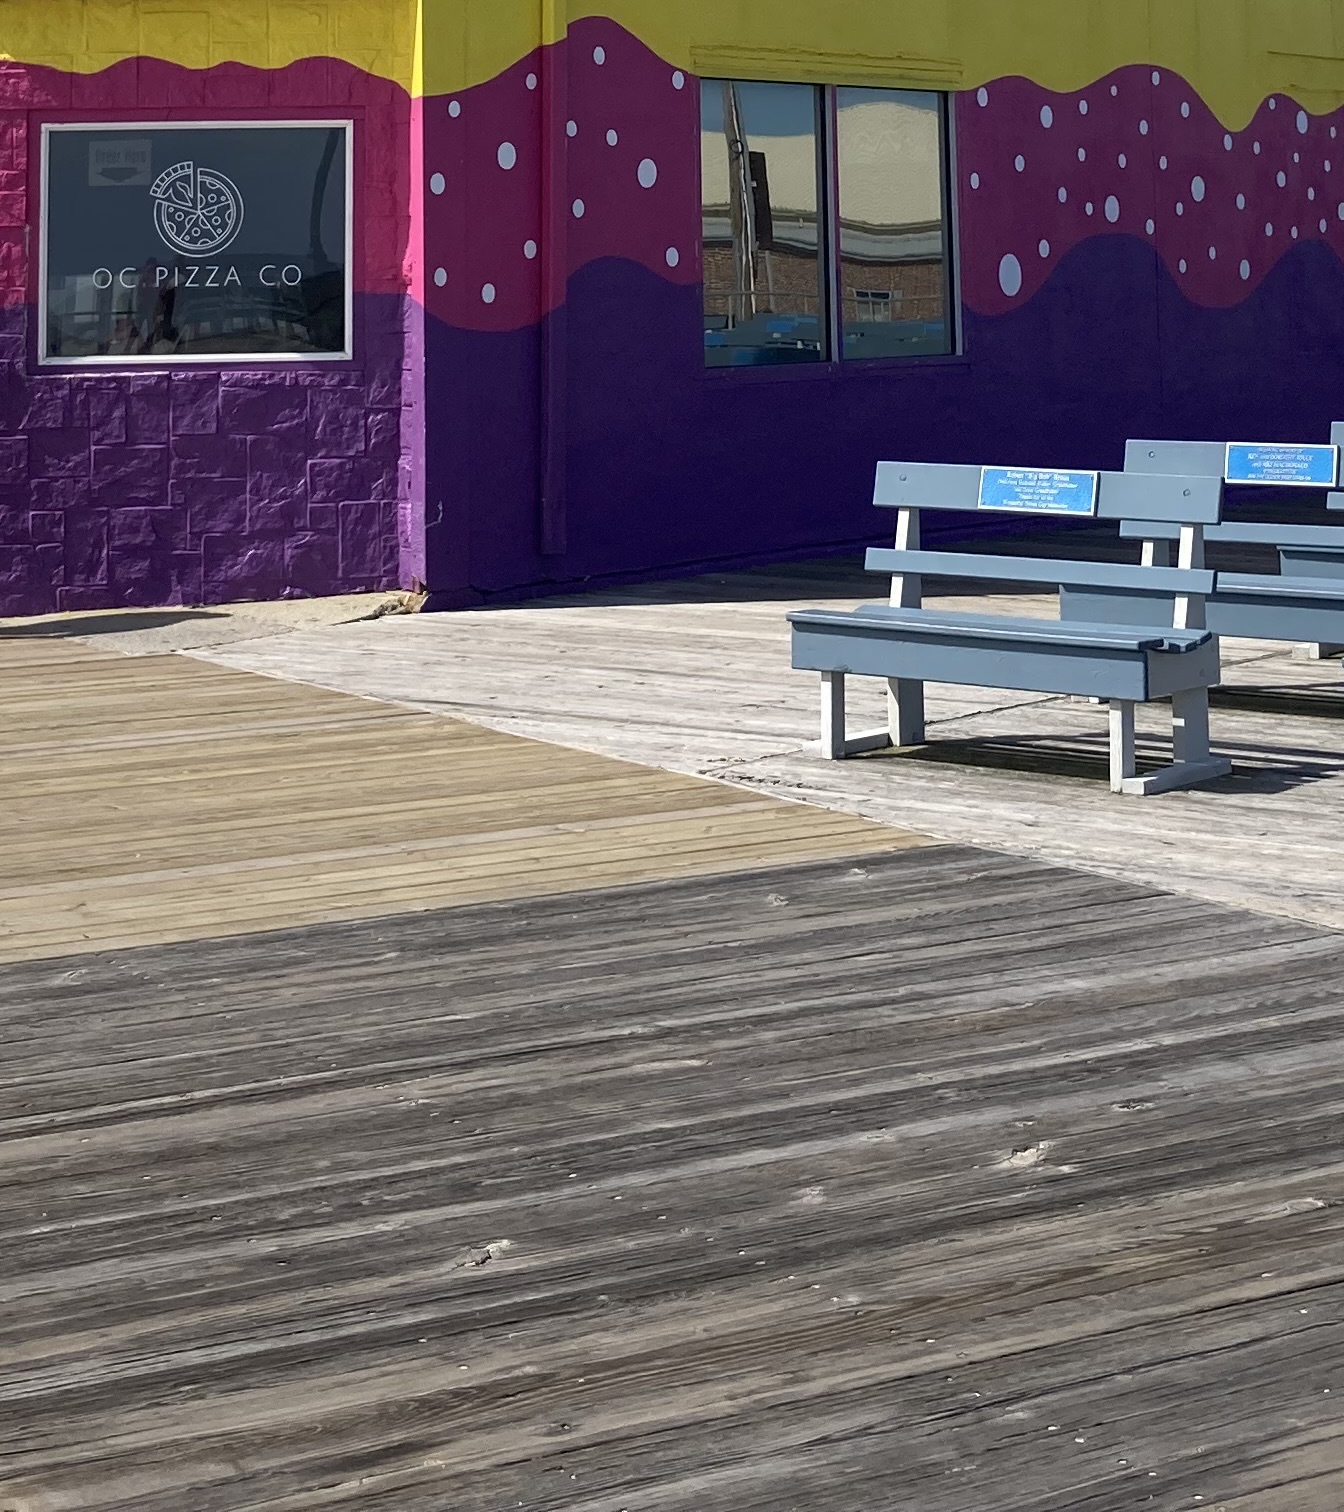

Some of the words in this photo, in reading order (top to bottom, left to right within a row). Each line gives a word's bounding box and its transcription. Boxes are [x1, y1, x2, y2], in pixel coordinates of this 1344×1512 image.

[92, 268, 136, 288] OC
[156, 266, 241, 287] PIZZA
[259, 264, 302, 286] CO
